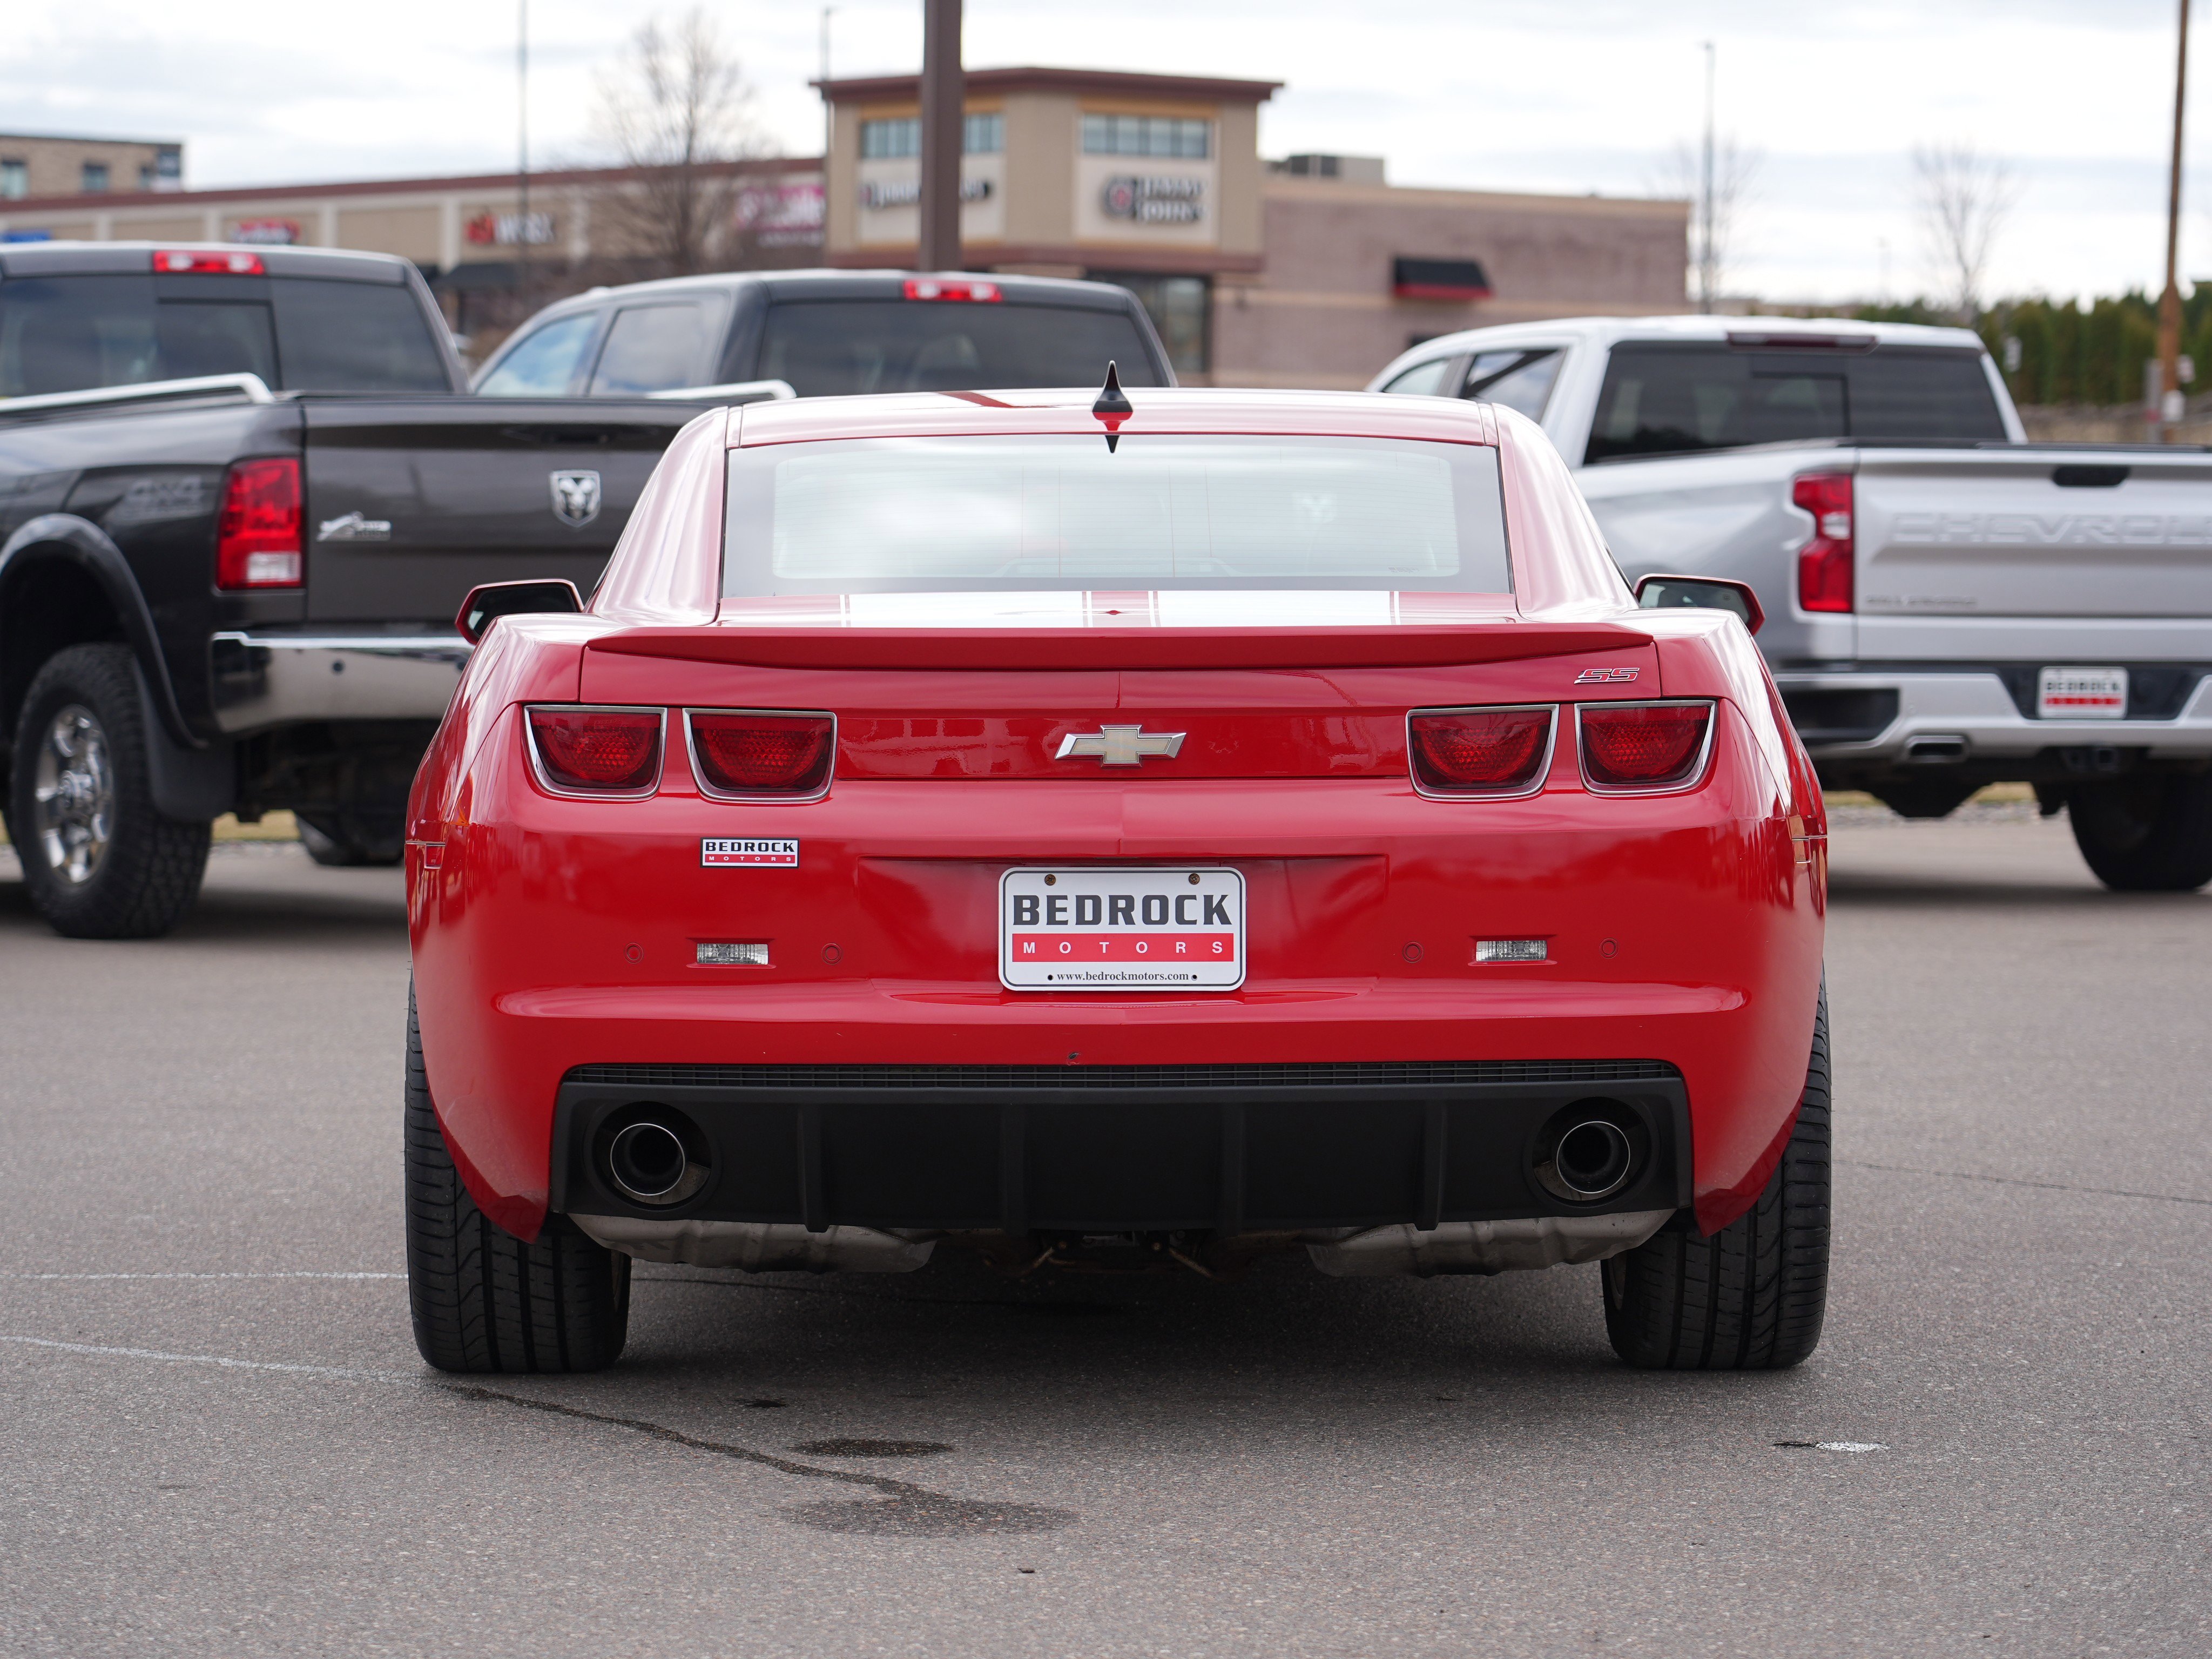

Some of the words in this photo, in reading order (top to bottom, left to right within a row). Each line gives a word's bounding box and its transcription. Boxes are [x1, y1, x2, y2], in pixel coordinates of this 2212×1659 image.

[1892, 512, 2212, 544] CHEVROL
[1574, 667, 1640, 684] SS
[705, 841, 795, 852] BEDROCK
[1013, 894, 1232, 926] BEDROCK
[1023, 941, 1223, 954] MOTORS
[1056, 972, 1189, 981] www.bedrockmotors.com
